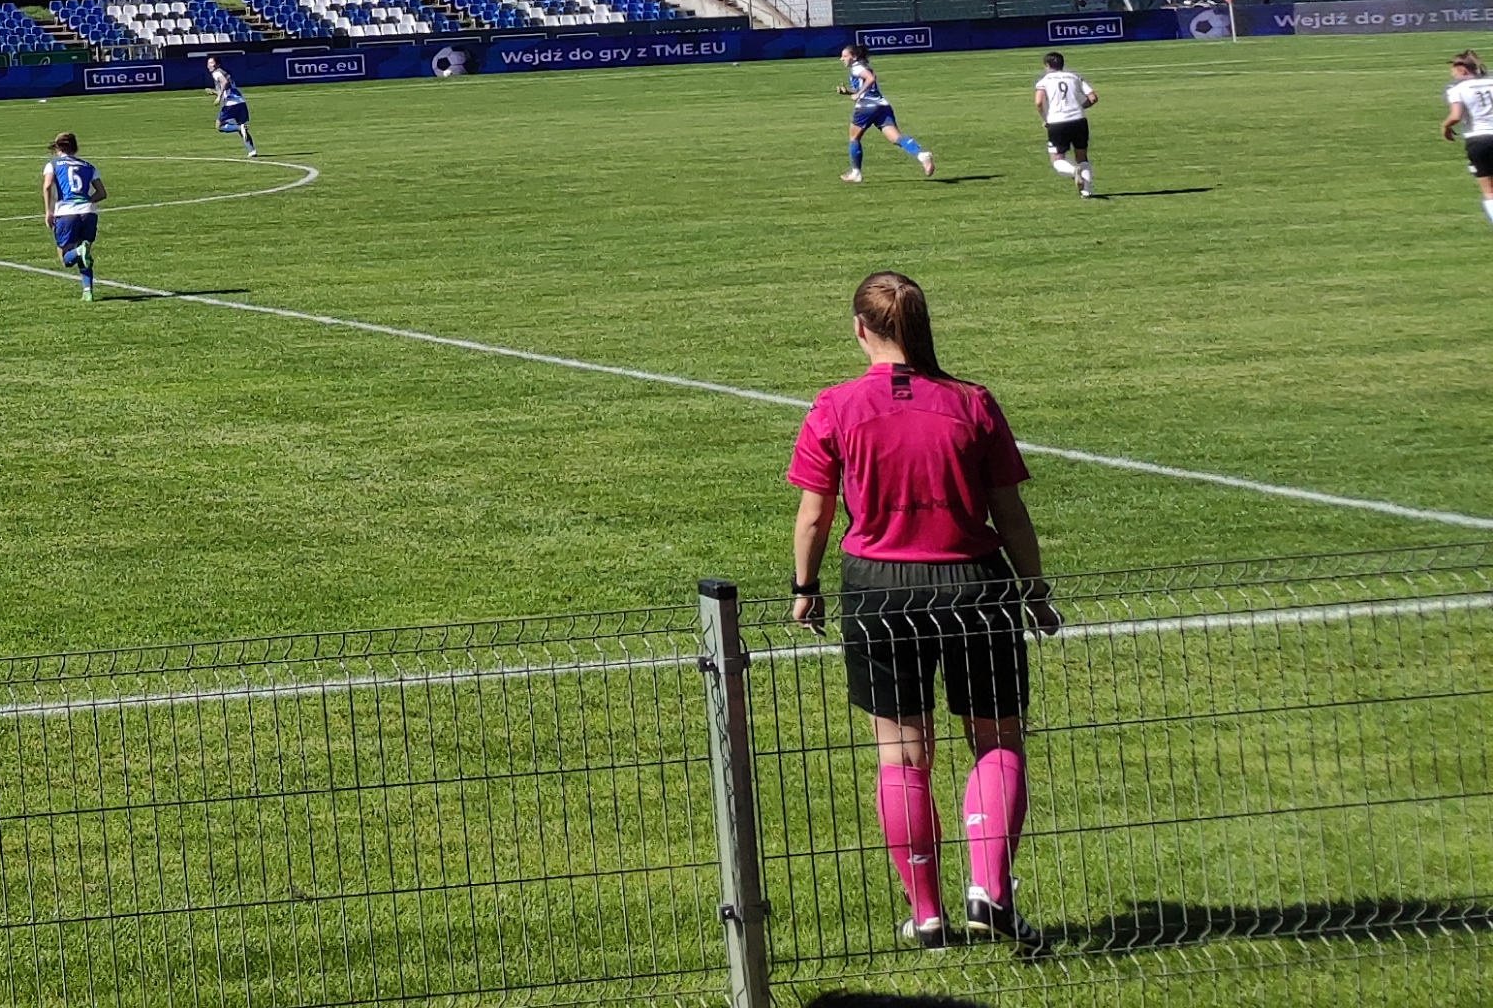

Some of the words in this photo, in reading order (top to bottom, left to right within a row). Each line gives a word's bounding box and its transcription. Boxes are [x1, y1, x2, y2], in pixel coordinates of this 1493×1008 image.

[1274, 12, 1348, 29] Wejdź
[1354, 11, 1385, 25] do
[1391, 12, 1424, 26] gry
[1427, 12, 1438, 22] z
[1055, 22, 1117, 36] tme.eu
[863, 33, 926, 46] tme.eu
[501, 48, 563, 66] Wejdź
[568, 47, 594, 61] do
[599, 46, 631, 62] gry
[637, 46, 648, 57] z
[652, 42, 727, 58] TME.EU
[294, 60, 358, 74] tme.eu
[91, 71, 157, 85] tme.eu
[1057, 81, 1069, 100] 9
[67, 166, 83, 193] 6
